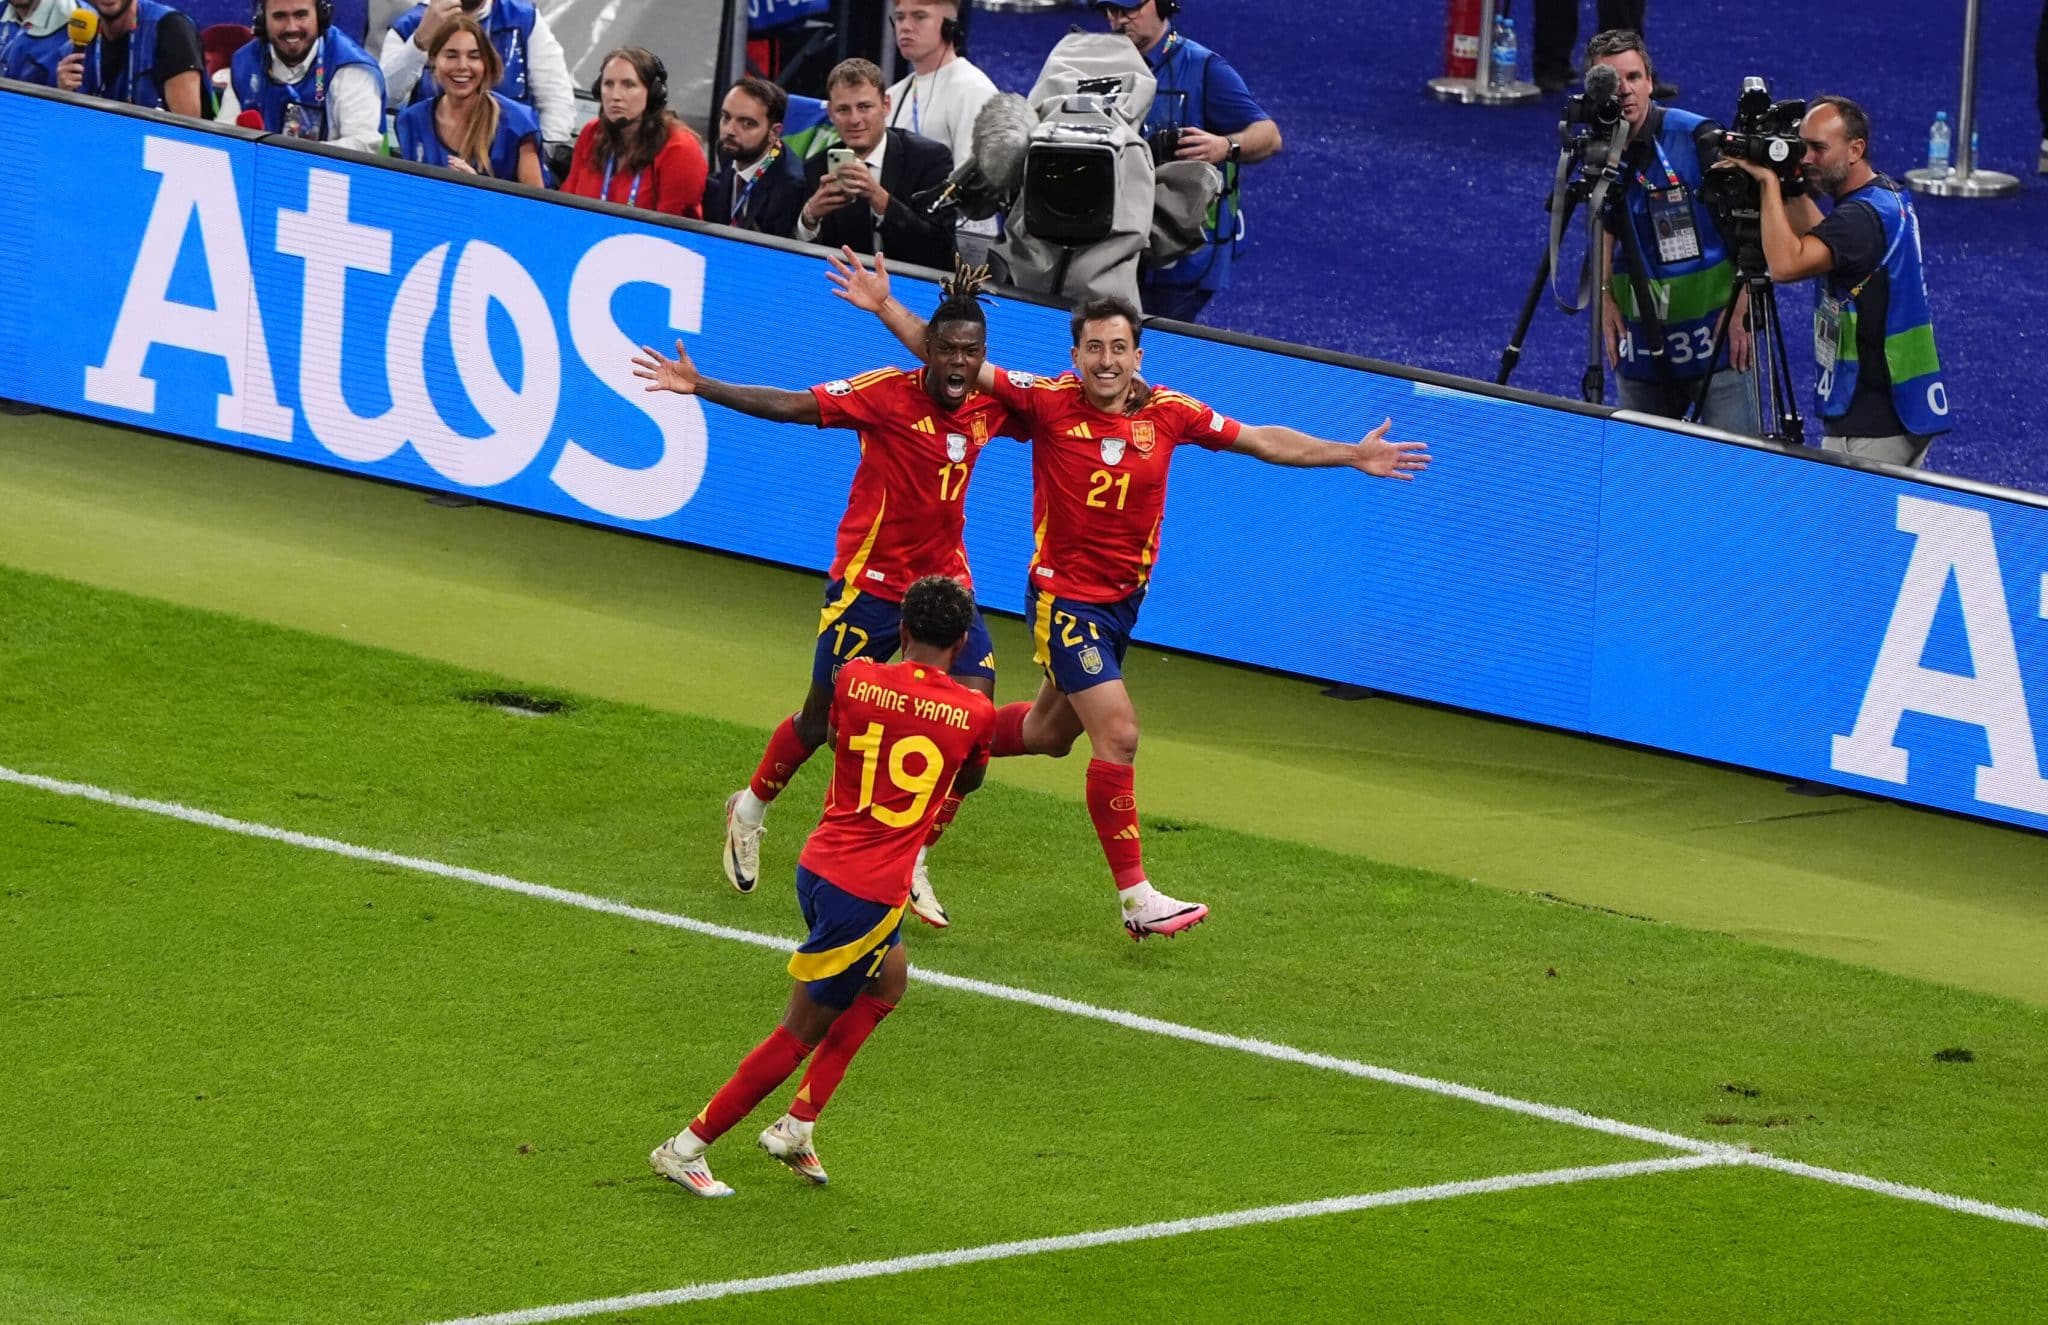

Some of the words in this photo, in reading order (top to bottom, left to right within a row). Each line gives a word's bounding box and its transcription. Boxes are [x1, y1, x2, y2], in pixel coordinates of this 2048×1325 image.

[939, 463, 968, 501] 17
[1086, 470, 1131, 510] 21
[833, 622, 869, 661] 17
[1831, 494, 2048, 816] A
[847, 677, 909, 713] LAMINE
[914, 697, 971, 731] YAMAL
[849, 721, 945, 829] 19
[866, 944, 891, 979] 1
